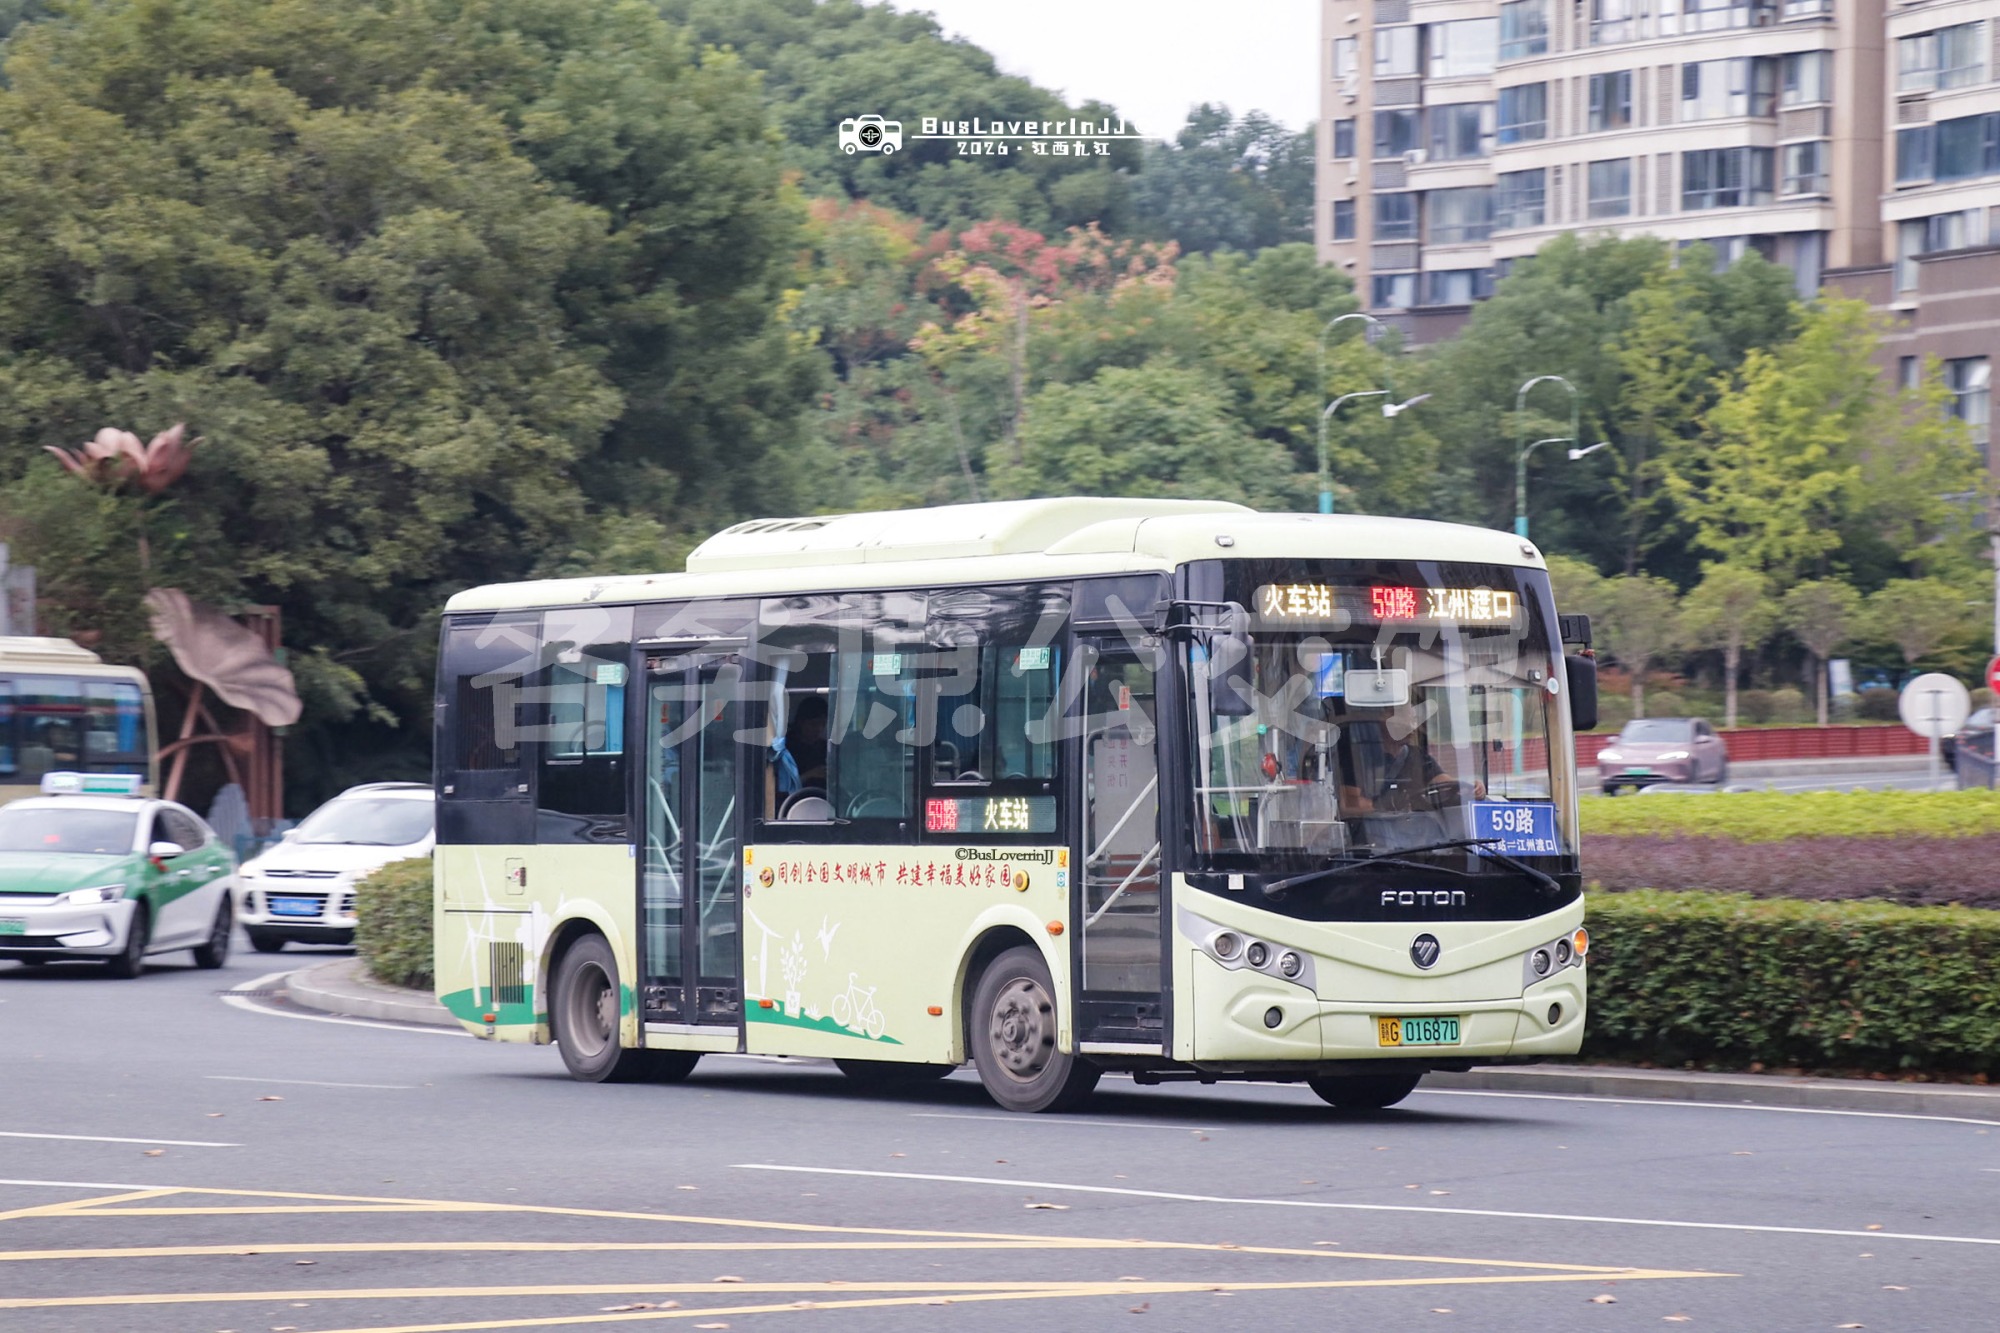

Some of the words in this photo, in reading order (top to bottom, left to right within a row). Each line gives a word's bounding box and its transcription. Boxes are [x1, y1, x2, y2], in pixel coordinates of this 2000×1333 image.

[1264, 583, 1331, 617] 火车站
[1372, 587, 1416, 619] 59路
[1426, 588, 1513, 620] 江州渡口
[927, 798, 958, 830] 59路
[984, 798, 1029, 830] 火车站
[1491, 807, 1534, 834] 59路
[1517, 837, 1555, 852] 江州渡口
[778, 860, 887, 887] 同创全国文明城市
[896, 861, 1011, 888] 共建幸福美好家园
[1381, 890, 1466, 906] FOTON
